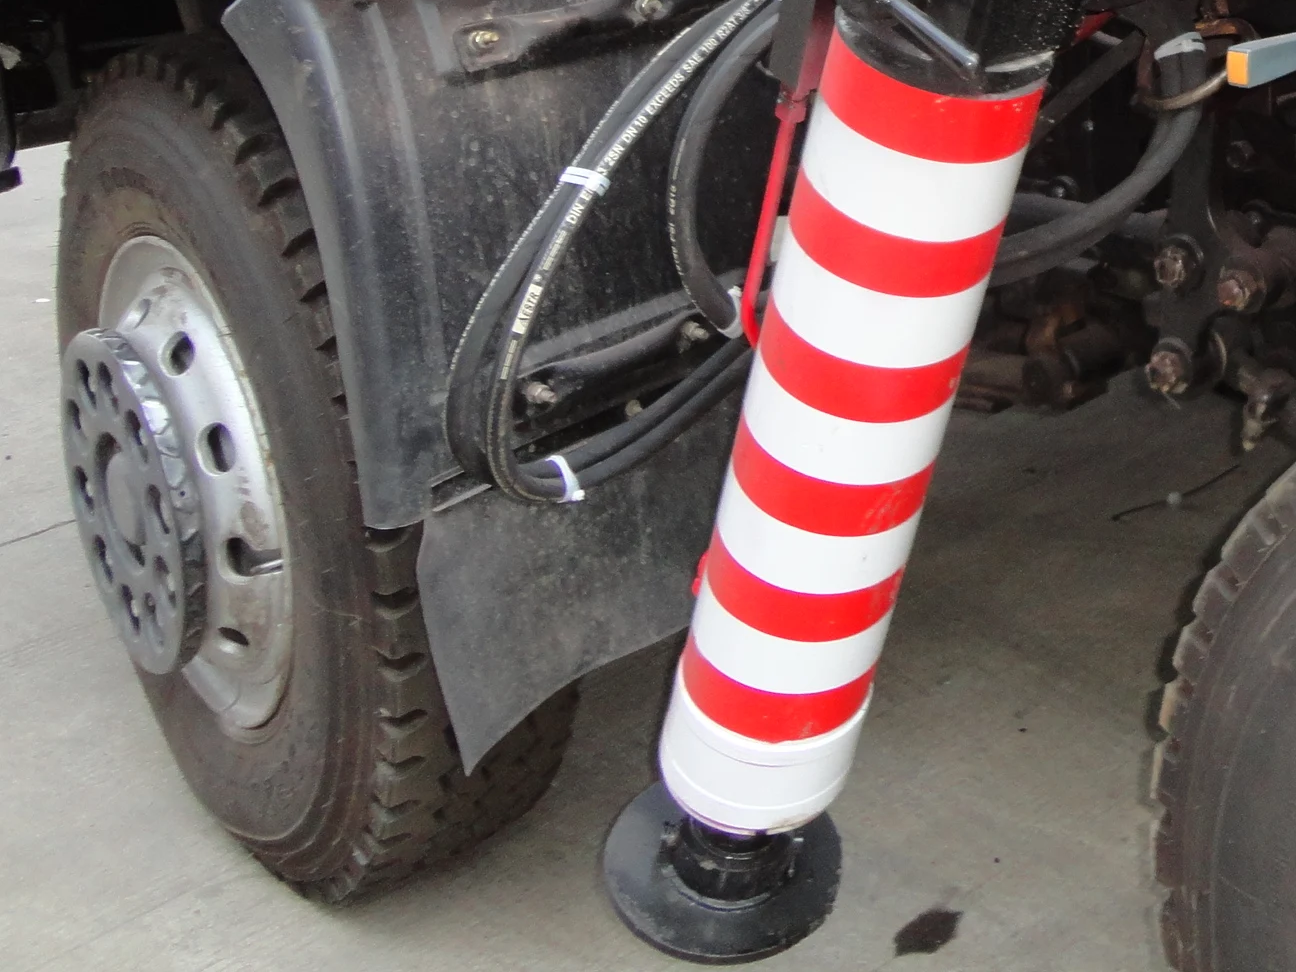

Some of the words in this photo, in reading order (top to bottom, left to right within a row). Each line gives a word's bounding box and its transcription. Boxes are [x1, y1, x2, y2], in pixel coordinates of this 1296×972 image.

[566, 202, 584, 225] DIN
[603, 144, 625, 167] 2SN
[622, 126, 639, 145] DN
[634, 115, 648, 129] 10
[645, 71, 685, 116] EXCEEDS
[682, 52, 705, 74] SAE
[701, 38, 718, 53] 100
[716, 19, 738, 40] R2AT
